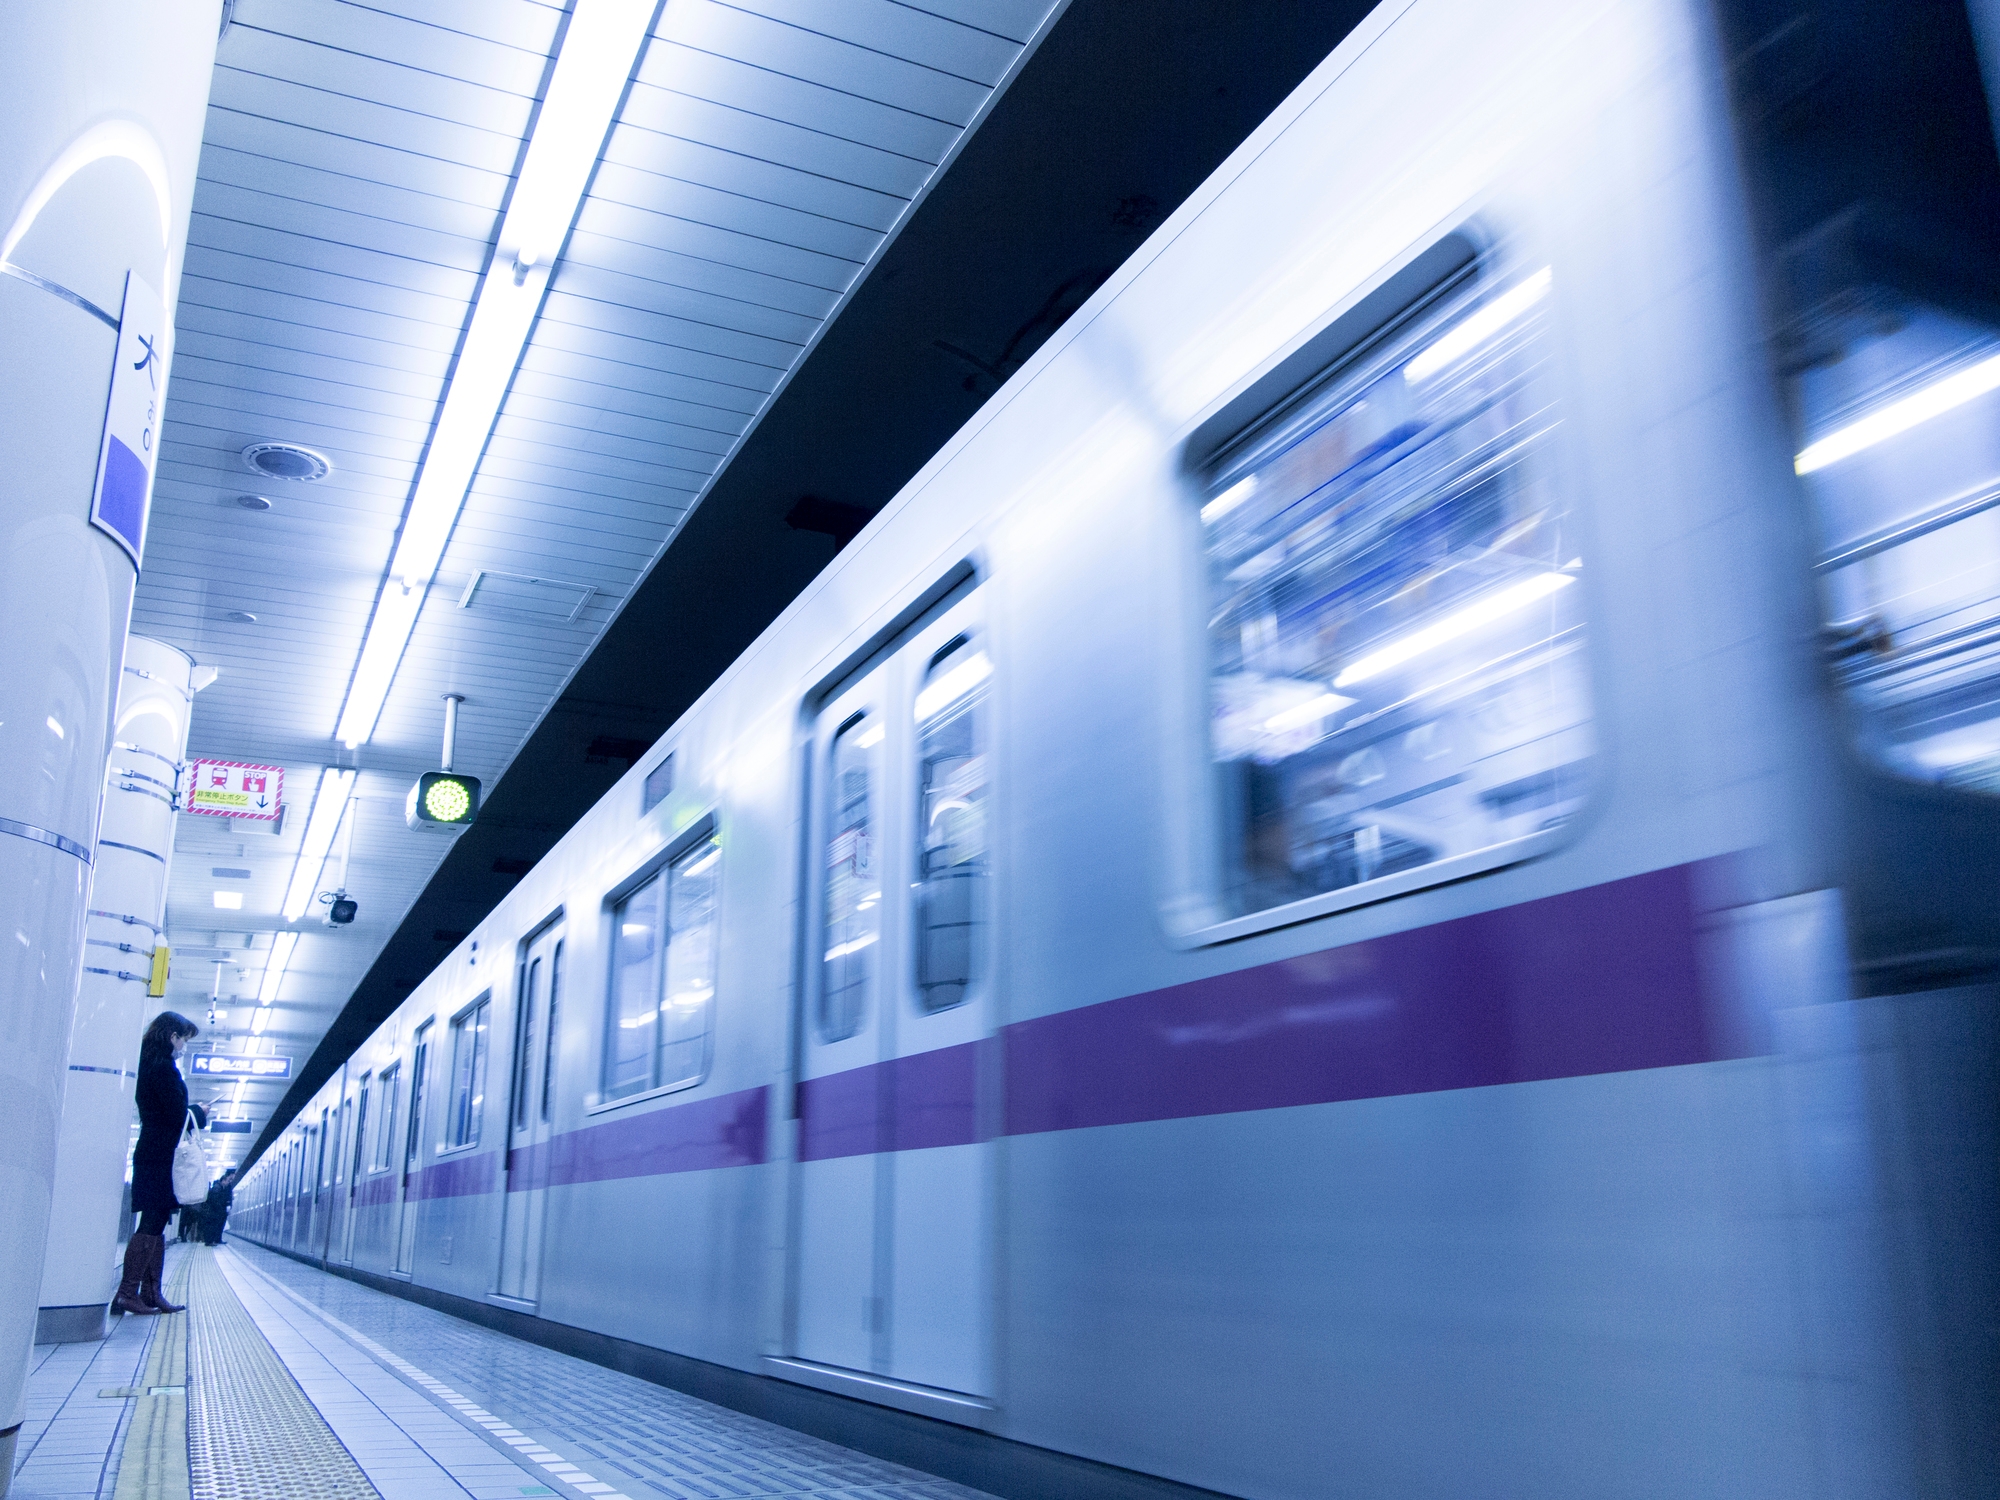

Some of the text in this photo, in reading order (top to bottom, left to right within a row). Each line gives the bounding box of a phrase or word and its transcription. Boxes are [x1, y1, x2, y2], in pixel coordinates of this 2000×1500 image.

[245, 771, 266, 779] STOP
[197, 790, 248, 801] 非常停止ボタン
